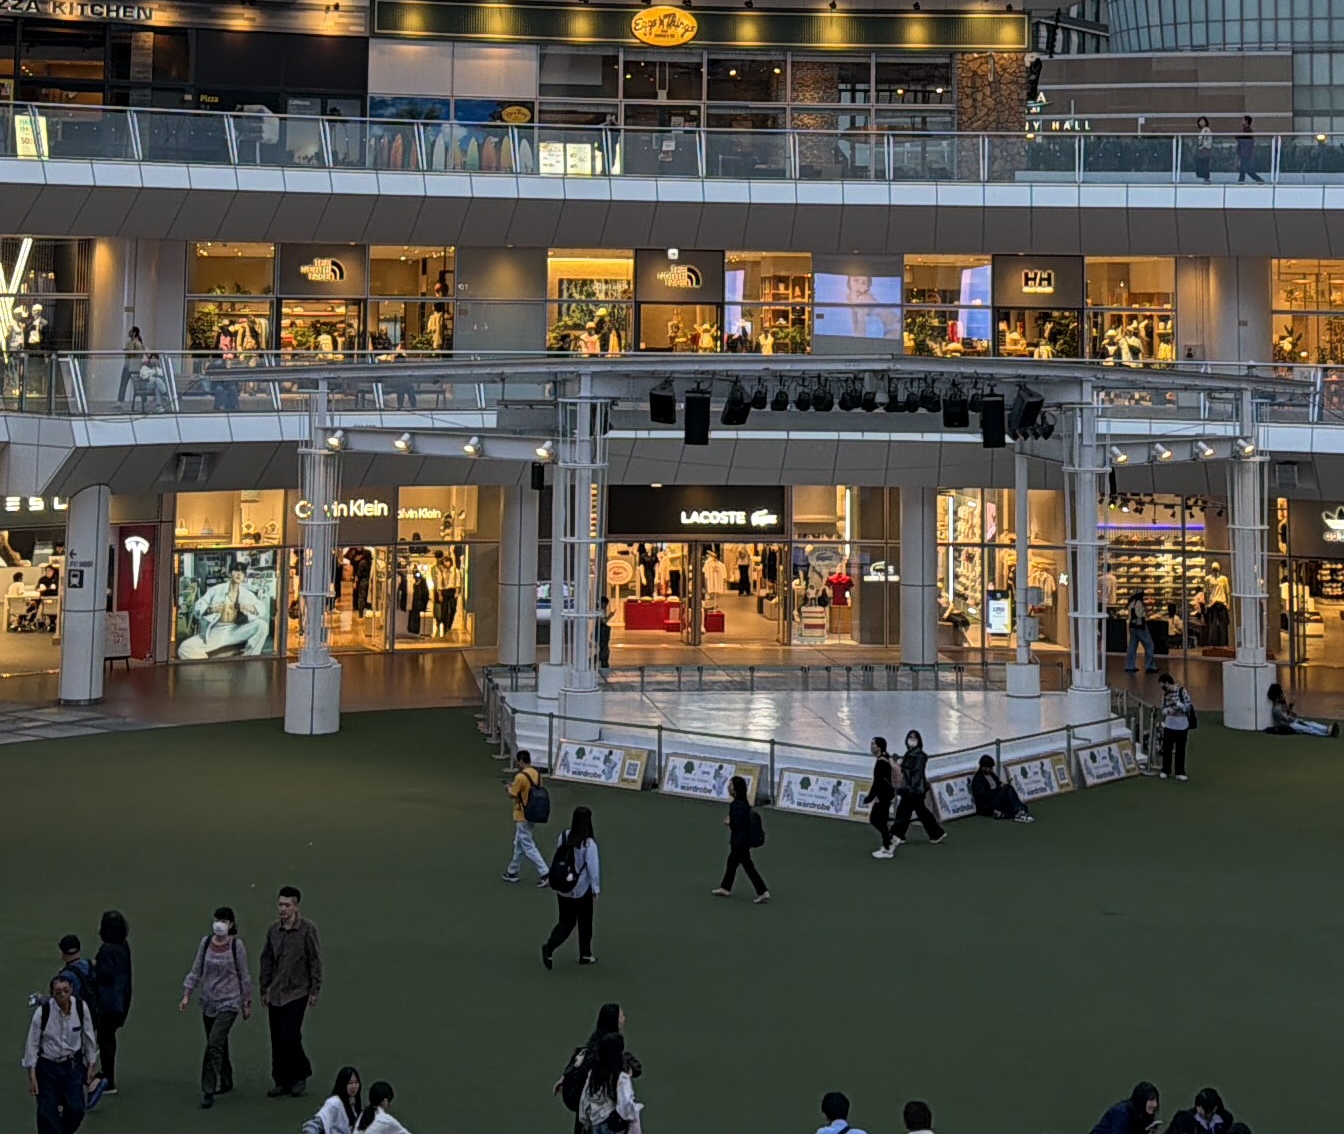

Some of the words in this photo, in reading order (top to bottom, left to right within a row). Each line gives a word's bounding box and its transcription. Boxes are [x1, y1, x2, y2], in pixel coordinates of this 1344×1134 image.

[50, 0, 153, 20] KITCHEN
[350, 499, 389, 518] Klein
[680, 510, 747, 525] LACOSTE
[571, 769, 603, 780] wardrobe
[680, 784, 713, 795] wardrobe
[796, 800, 832, 812] wardrobe
